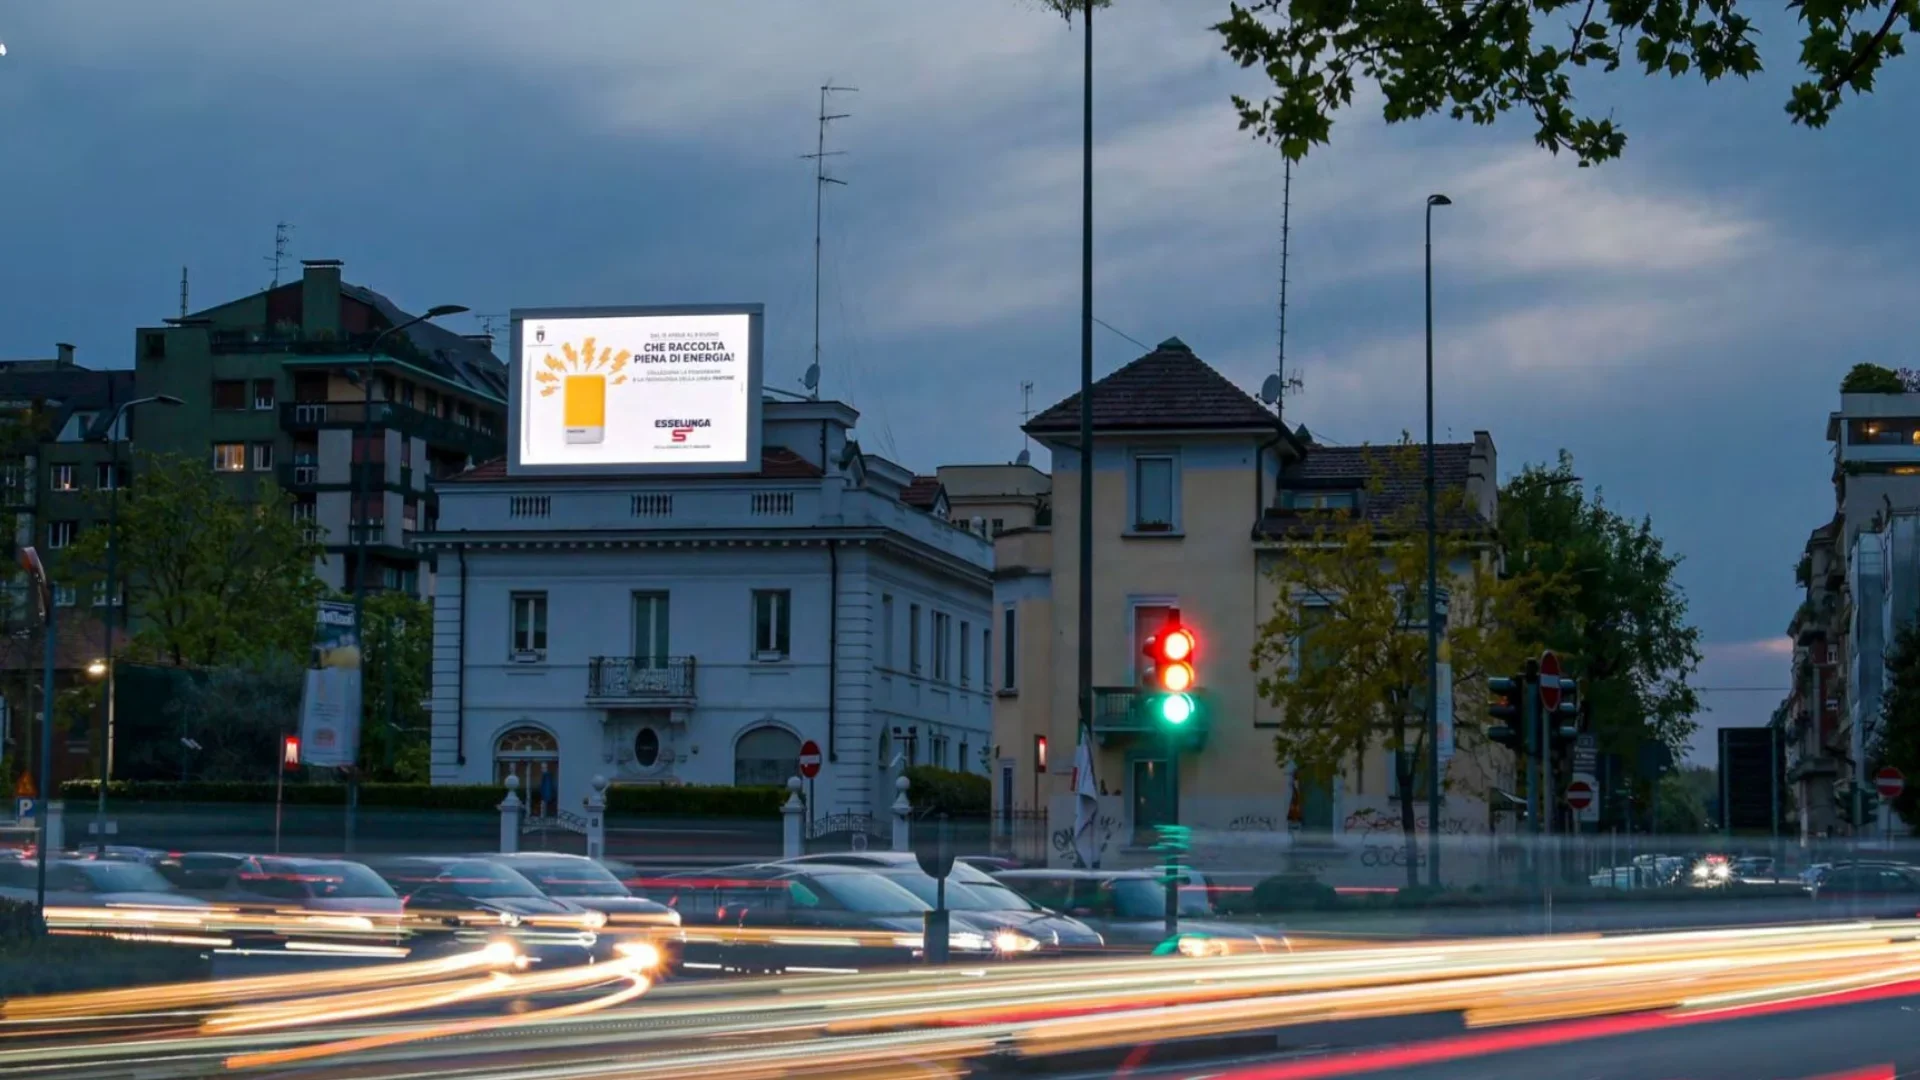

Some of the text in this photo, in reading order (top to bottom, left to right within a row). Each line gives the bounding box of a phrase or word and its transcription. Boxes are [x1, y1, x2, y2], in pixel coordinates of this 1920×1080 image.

[644, 341, 725, 352] CHE RACCOLTA
[634, 352, 735, 363] PIENA DI ENERGIA!
[655, 418, 711, 428] ESSELUNGA
[19, 799, 33, 816] P
